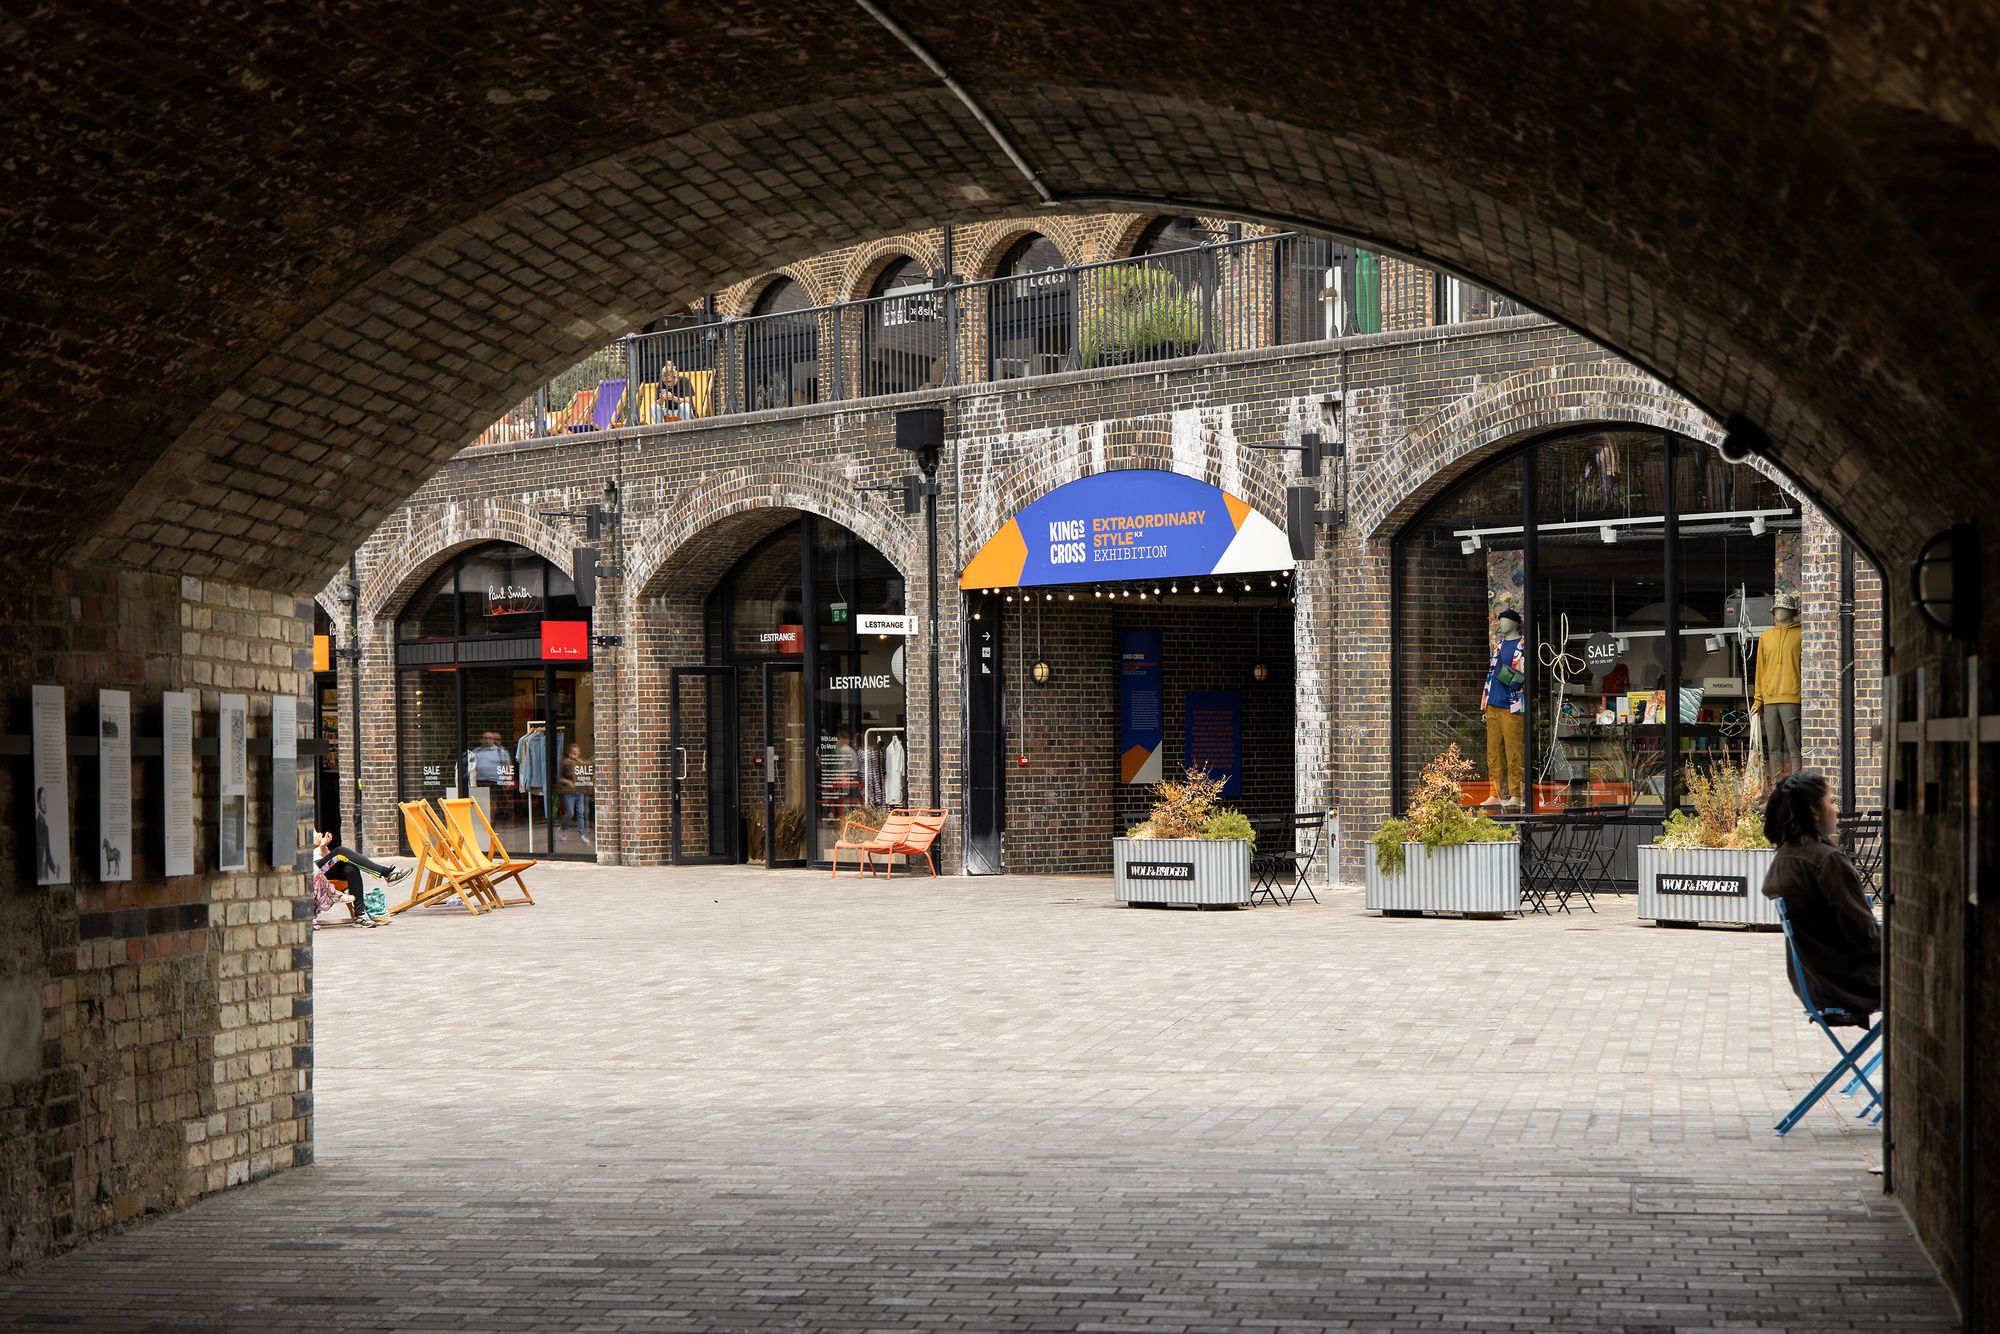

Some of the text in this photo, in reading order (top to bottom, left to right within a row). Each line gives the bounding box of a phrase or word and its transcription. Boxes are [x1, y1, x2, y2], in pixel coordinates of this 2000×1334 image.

[1092, 510, 1206, 532] EXTRAORDINARY
[1049, 519, 1085, 542] KINGS
[1093, 531, 1133, 547] STYLE
[1050, 542, 1086, 564] CROSS
[1093, 545, 1167, 562] EXHIBITION
[488, 585, 533, 601] Paul Smith
[865, 621, 904, 629] LESTRANGE
[760, 632, 796, 642] LESTRANGE
[1588, 643, 1615, 659] SALE
[829, 675, 891, 690] LESTRANGE
[423, 765, 441, 776] SALE
[497, 765, 515, 776] SALE
[574, 765, 594, 776] SALE
